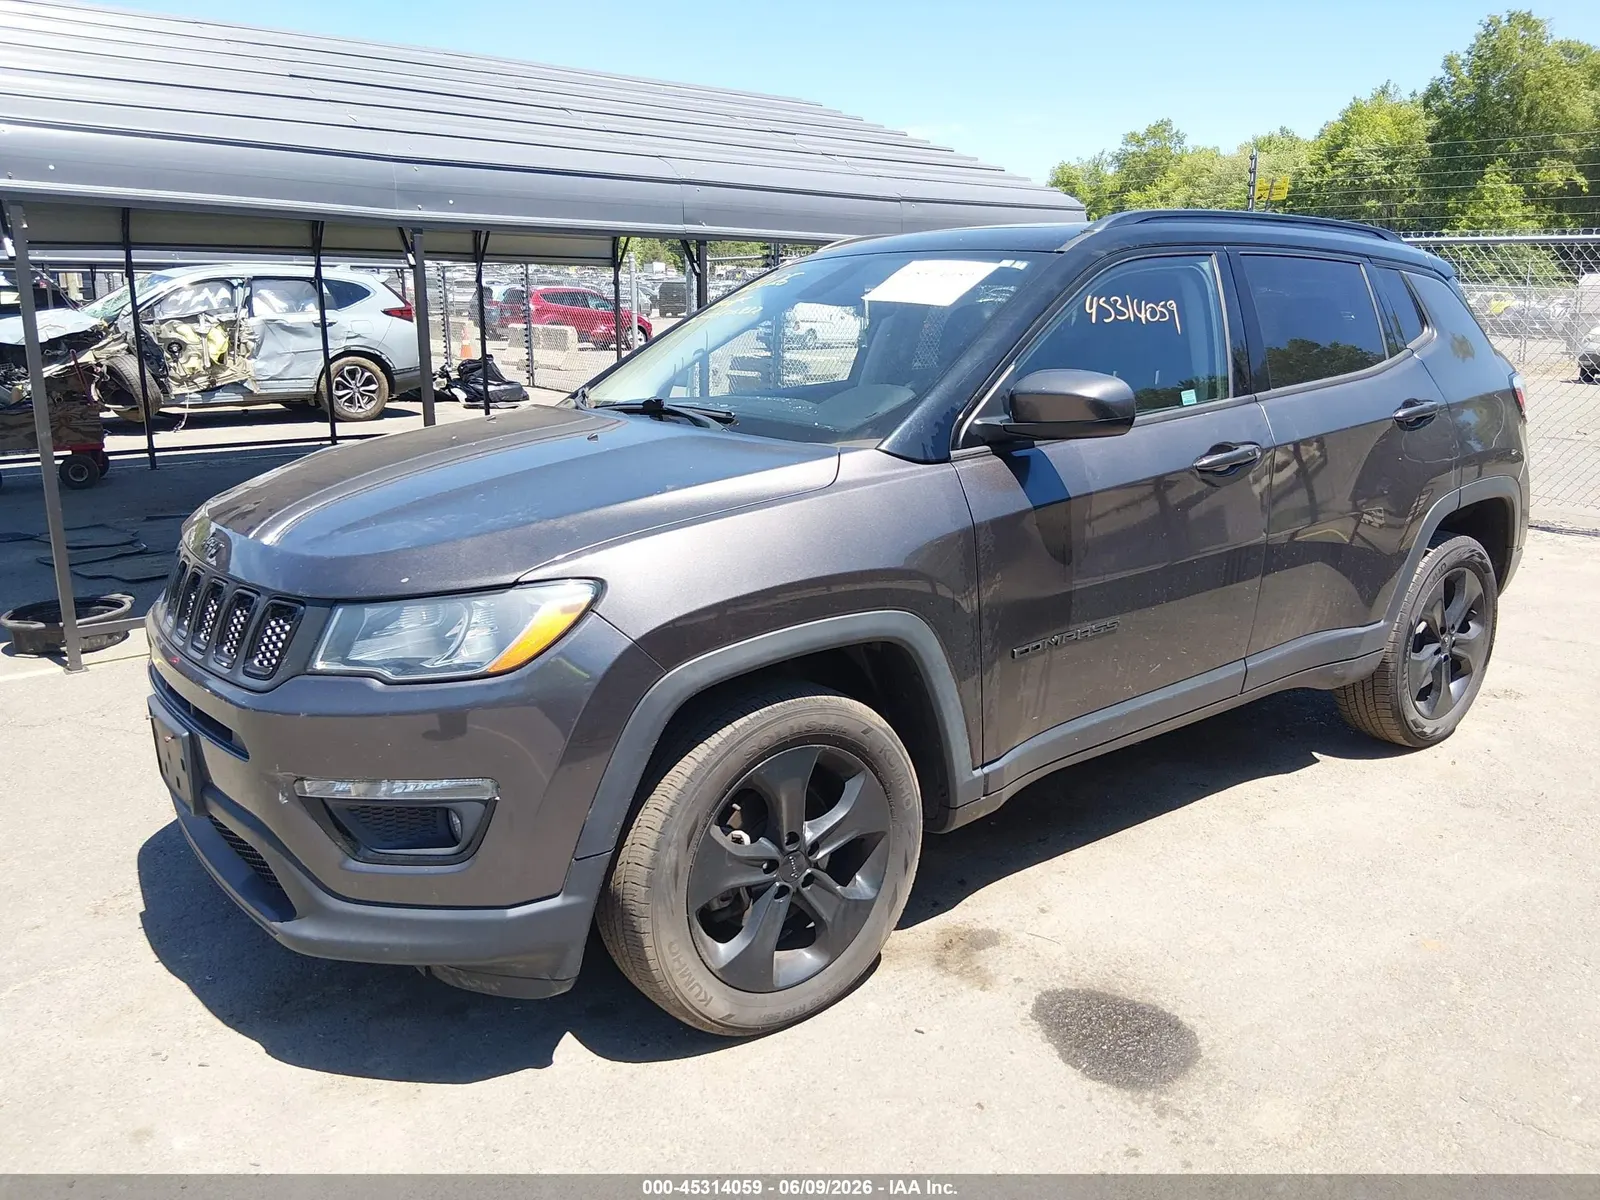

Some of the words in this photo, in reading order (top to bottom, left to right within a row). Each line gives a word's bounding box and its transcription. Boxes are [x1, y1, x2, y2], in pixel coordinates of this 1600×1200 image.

[1085, 294, 1181, 335] 45314059
[1010, 616, 1121, 659] COMPASS
[667, 940, 714, 1008] KUMHO
